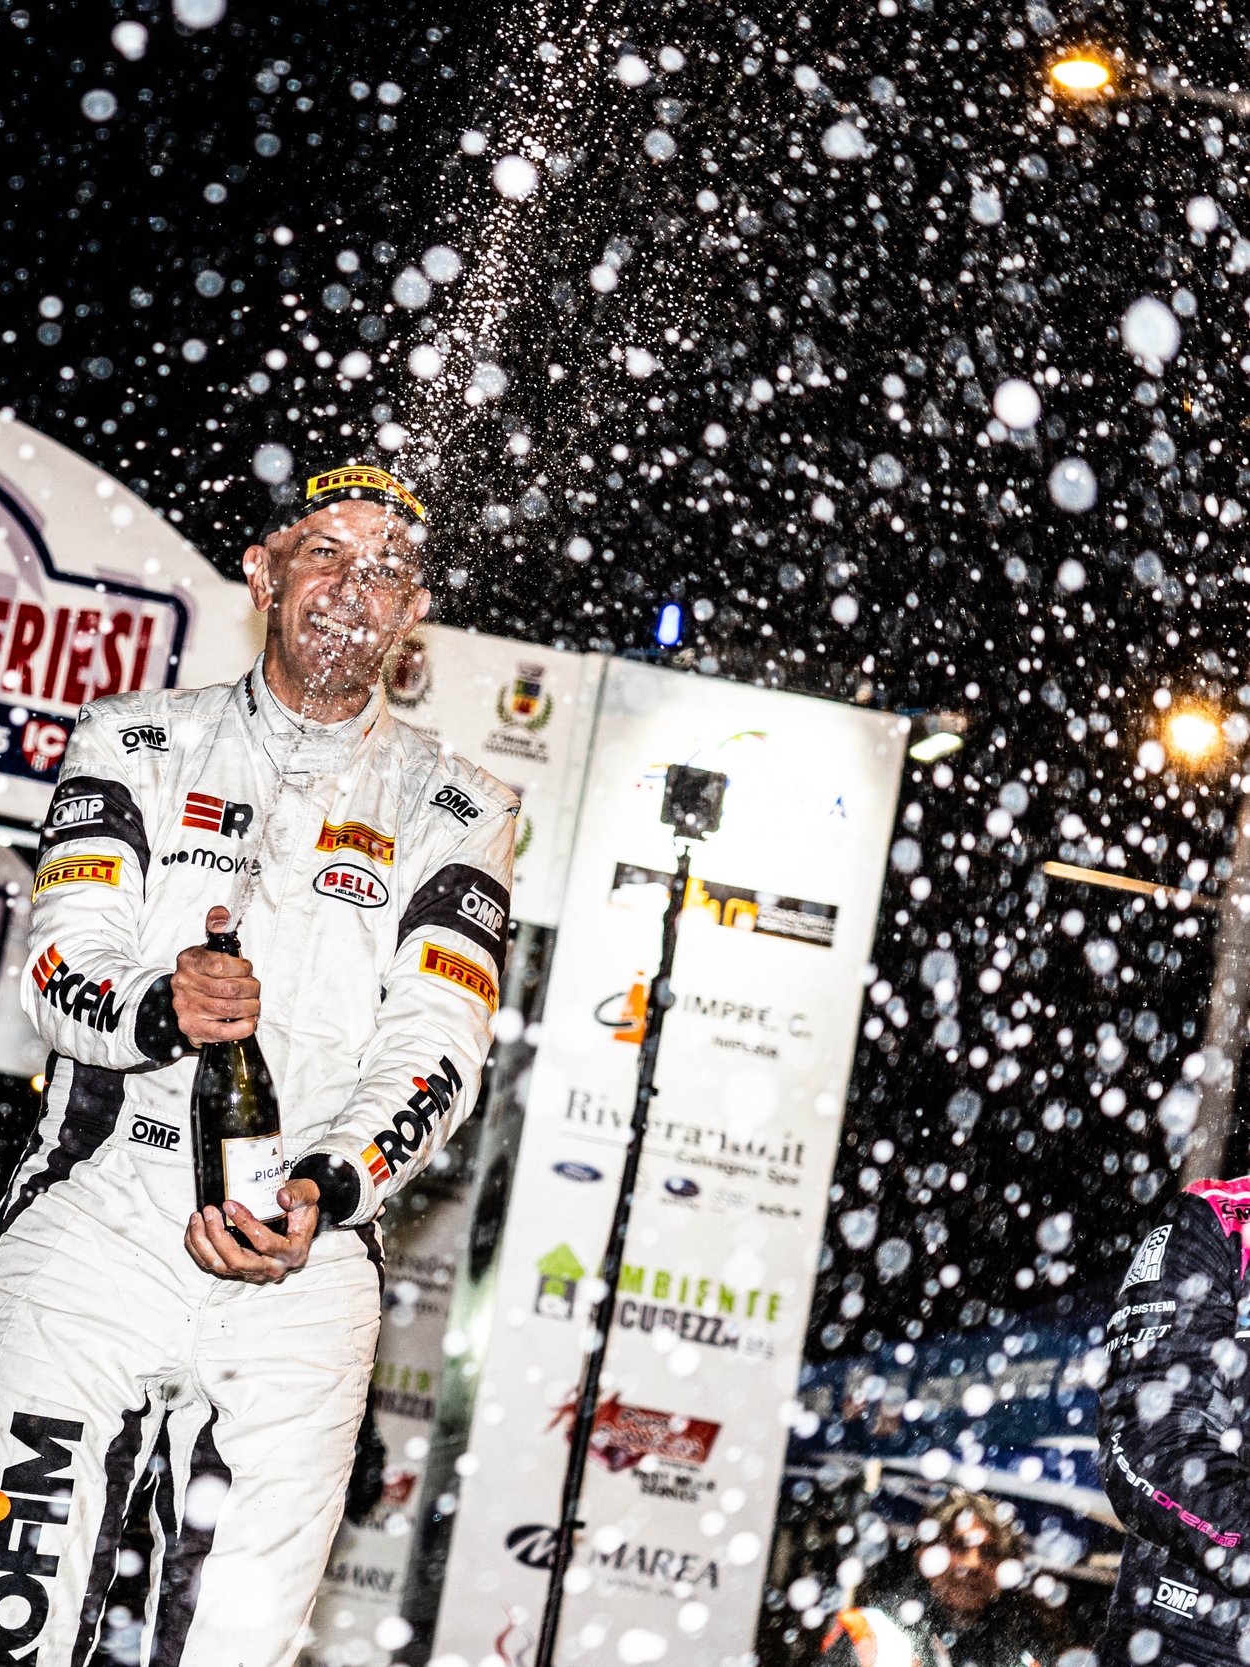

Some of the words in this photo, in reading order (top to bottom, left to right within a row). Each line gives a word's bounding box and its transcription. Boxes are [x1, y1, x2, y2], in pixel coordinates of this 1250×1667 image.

[122, 728, 167, 749] OMP
[52, 798, 104, 827] OMP
[435, 789, 479, 819] OMP
[35, 860, 115, 896] PIRELLI
[323, 871, 378, 901] BELL
[334, 886, 365, 903] HELMETS
[461, 892, 503, 931] OMP
[132, 1121, 181, 1148] OMP
[1131, 1301, 1176, 1315] SISTEMI
